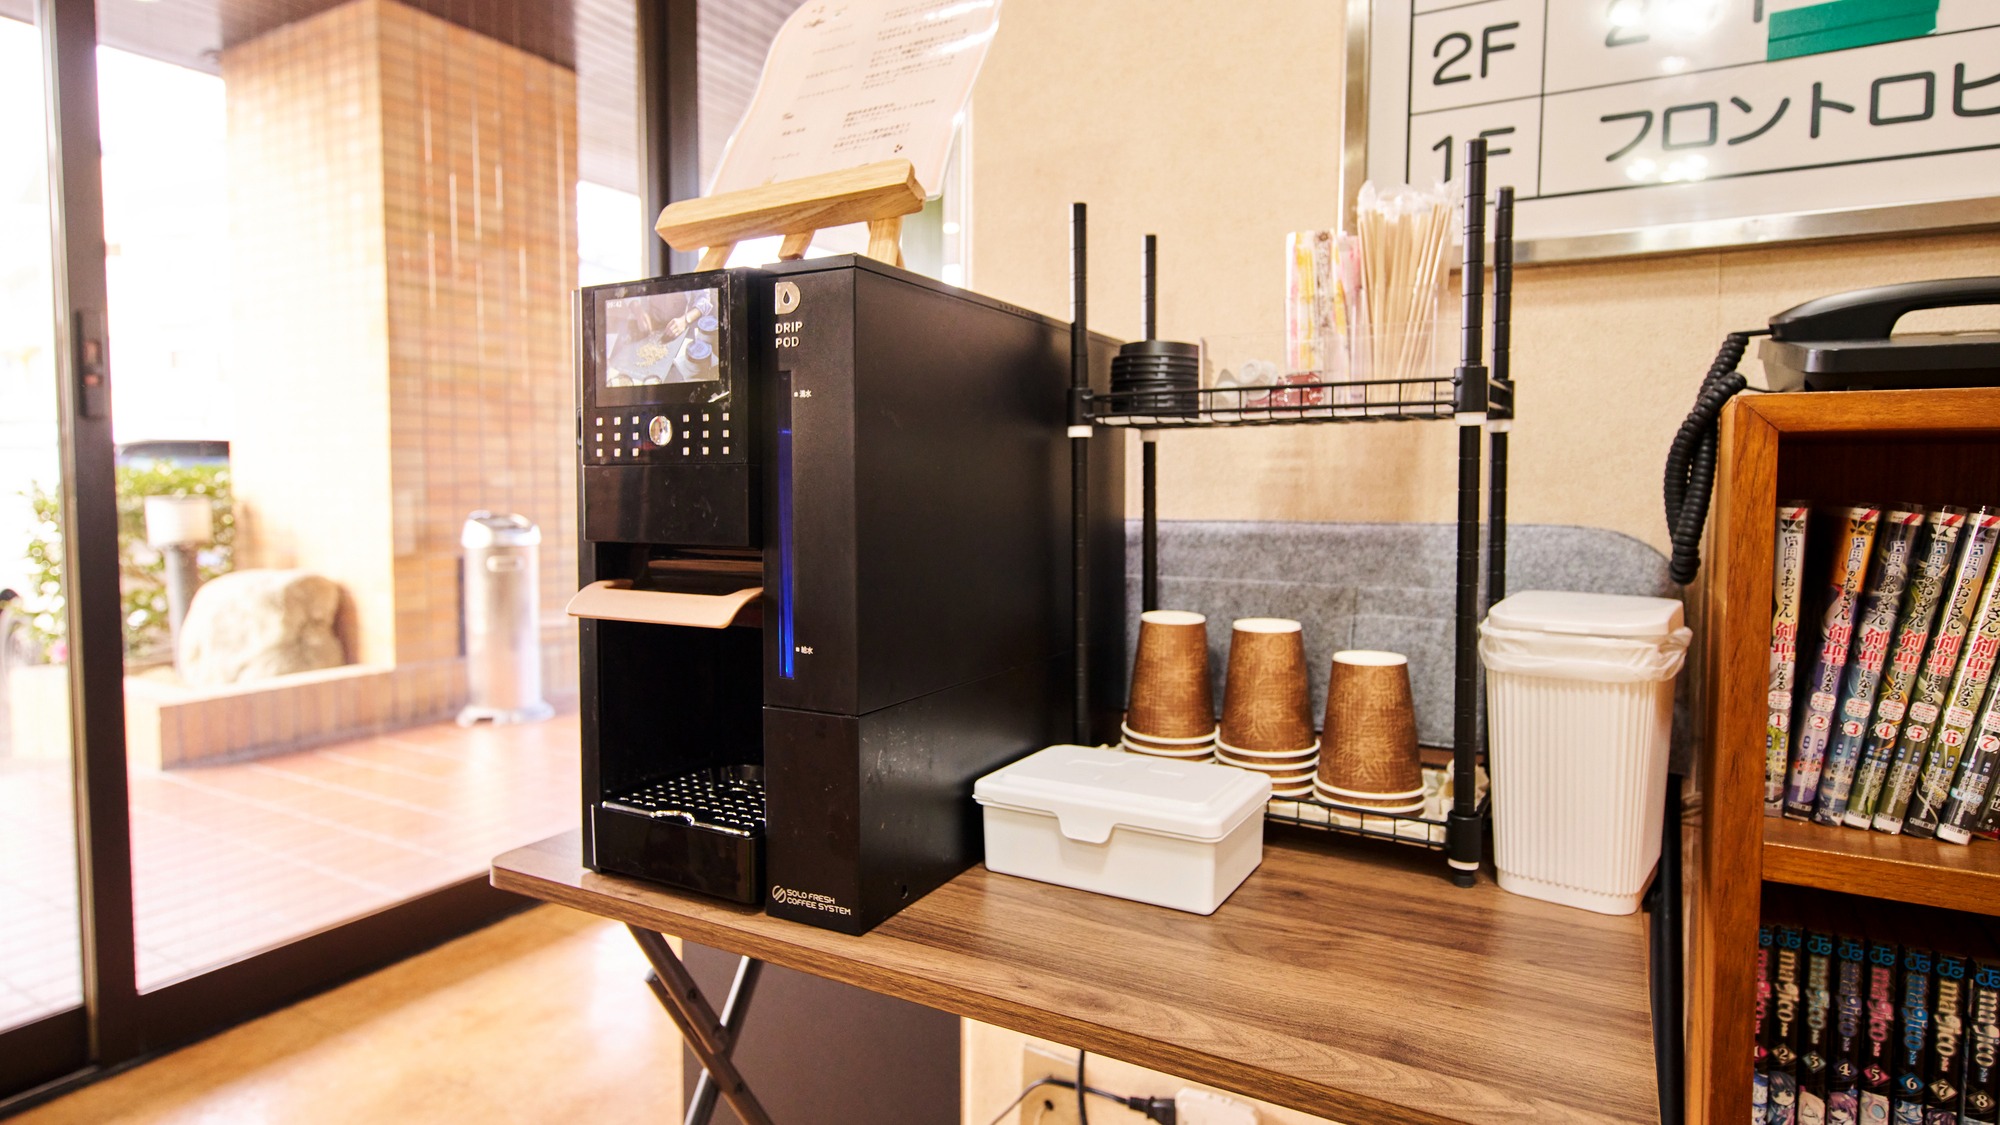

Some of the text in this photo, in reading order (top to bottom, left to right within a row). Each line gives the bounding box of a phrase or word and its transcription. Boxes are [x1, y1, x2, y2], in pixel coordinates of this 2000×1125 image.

[1433, 21, 1520, 85] 2F
[775, 321, 803, 334] DRIP
[775, 336, 800, 349] POD
[1775, 714, 1781, 727] 1
[1814, 717, 1824, 728] 2
[1847, 722, 1858, 735] 3
[1879, 725, 1890, 737] 4
[1910, 726, 1922, 739] 5
[1945, 732, 1958, 744] 6
[1984, 736, 1995, 749] 7
[787, 889, 835, 904] SOLO FRESH
[787, 897, 851, 915] COFFEE SYSTEM
[1775, 949, 1800, 1022] magico
[1867, 966, 1894, 1042] magico
[1902, 973, 1928, 1050] magico
[1934, 979, 1962, 1057] magico
[1973, 989, 2000, 1067] magico
[1779, 1048, 1789, 1060] 2
[1810, 1055, 1819, 1068] 3
[1838, 1062, 1851, 1076] 4
[1871, 1068, 1880, 1081] 5
[1906, 1077, 1917, 1090] 6
[1938, 1084, 1948, 1097] 7
[1976, 1094, 1988, 1108] 8
